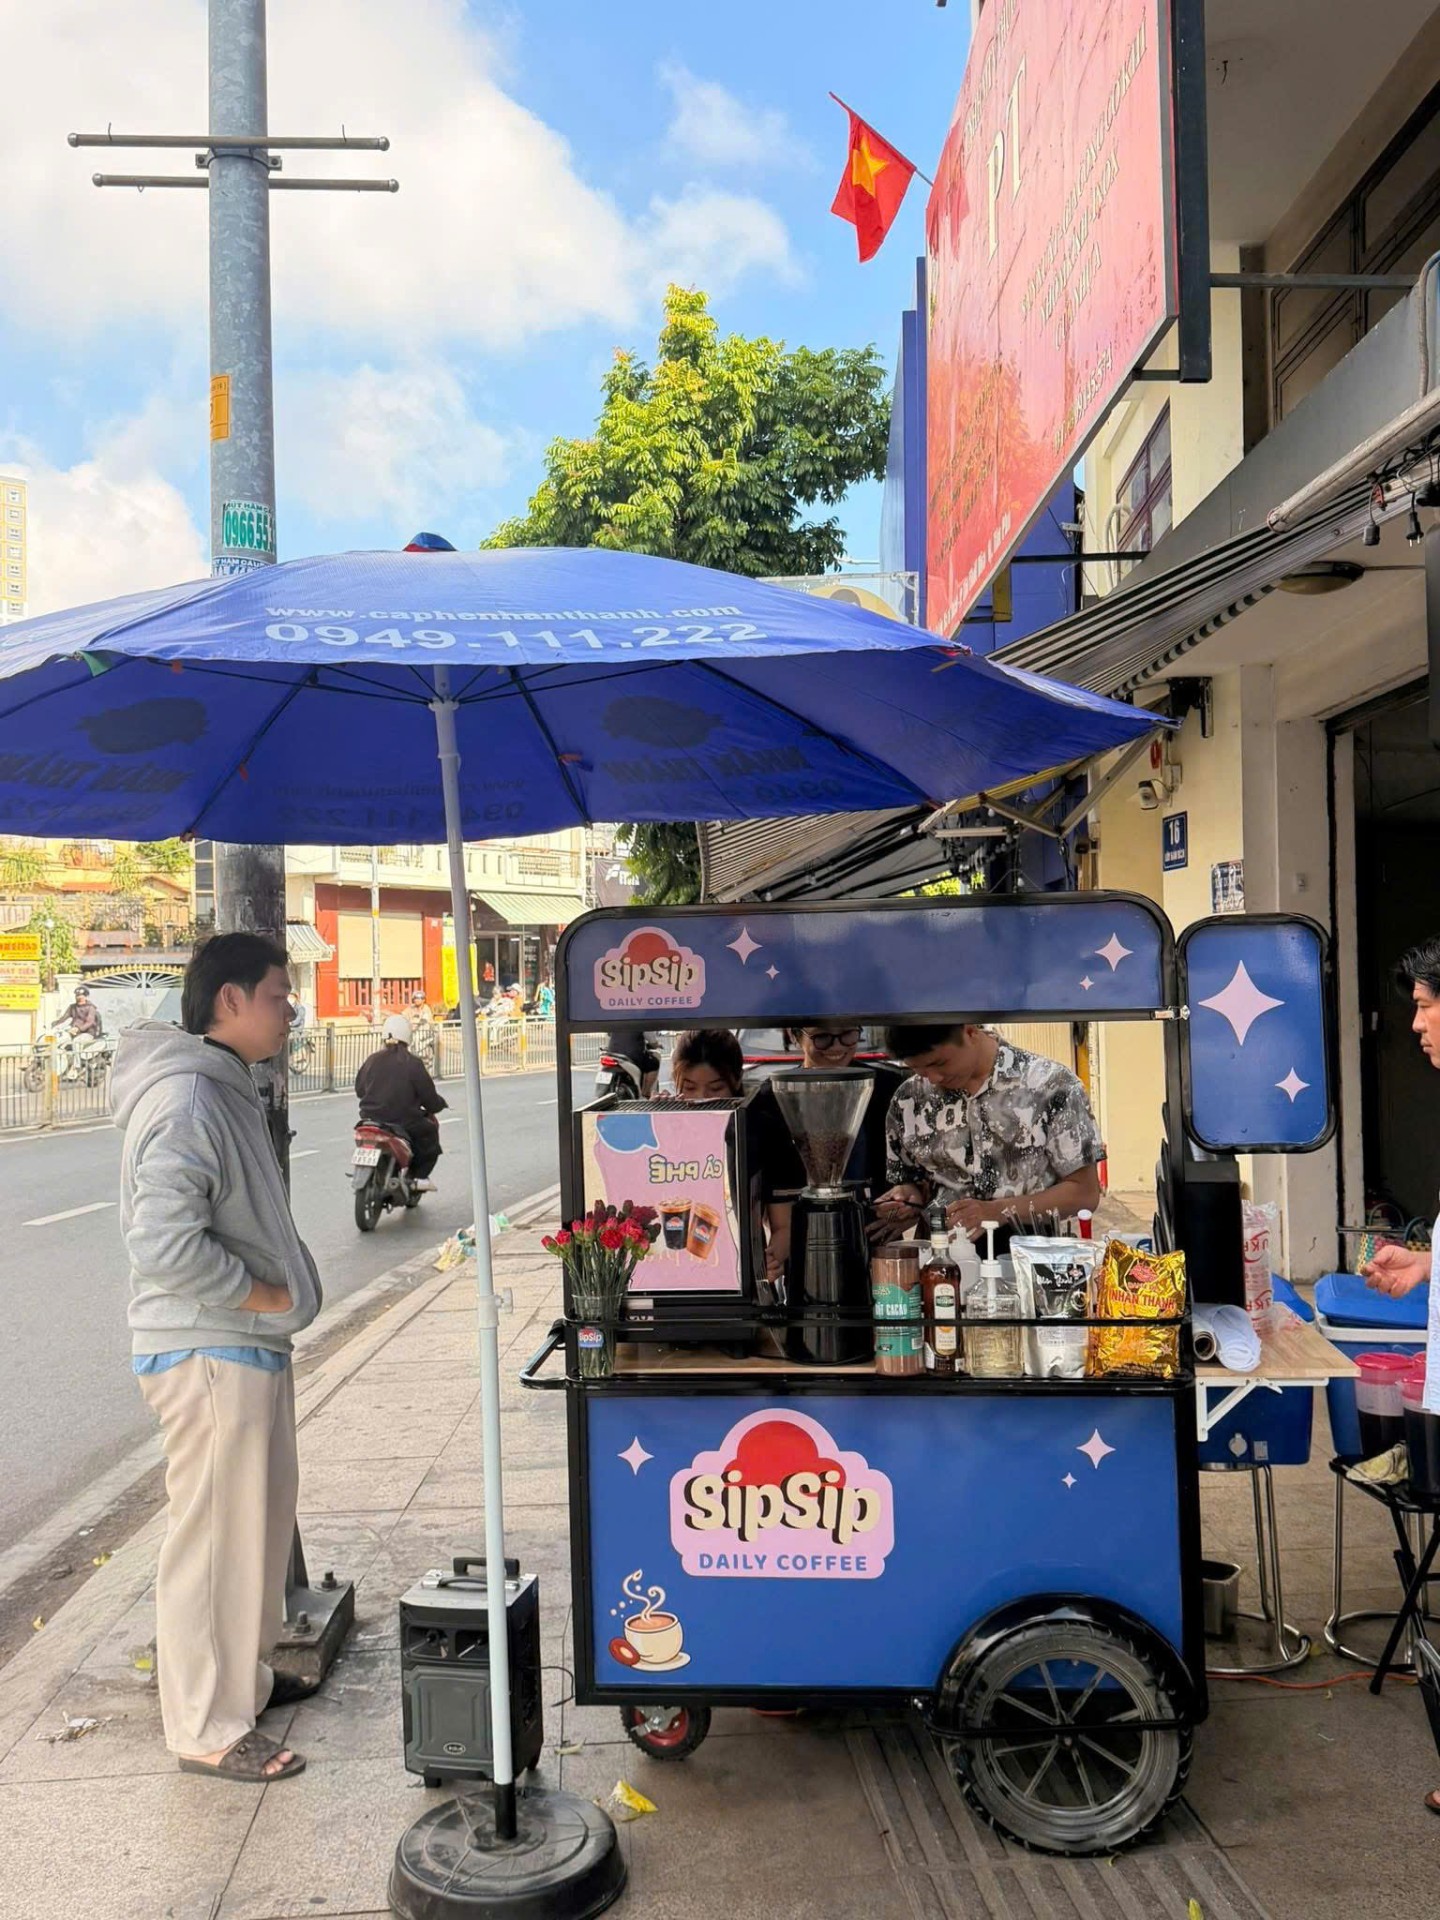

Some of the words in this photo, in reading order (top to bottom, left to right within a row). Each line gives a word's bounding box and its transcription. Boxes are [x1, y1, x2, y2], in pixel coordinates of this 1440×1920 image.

[985, 52, 1027, 267] PT
[266, 605, 743, 622] www.caphenhanthanh.com
[265, 623, 767, 648] 0949.111.222
[1169, 820, 1180, 845] 16
[601, 955, 699, 993] SipSip
[608, 997, 643, 1007] DAILY
[647, 996, 693, 1006] COFFEE
[683, 1469, 881, 1544] SipSip
[699, 1553, 768, 1570] DAILY
[776, 1555, 868, 1571] COFFEE
